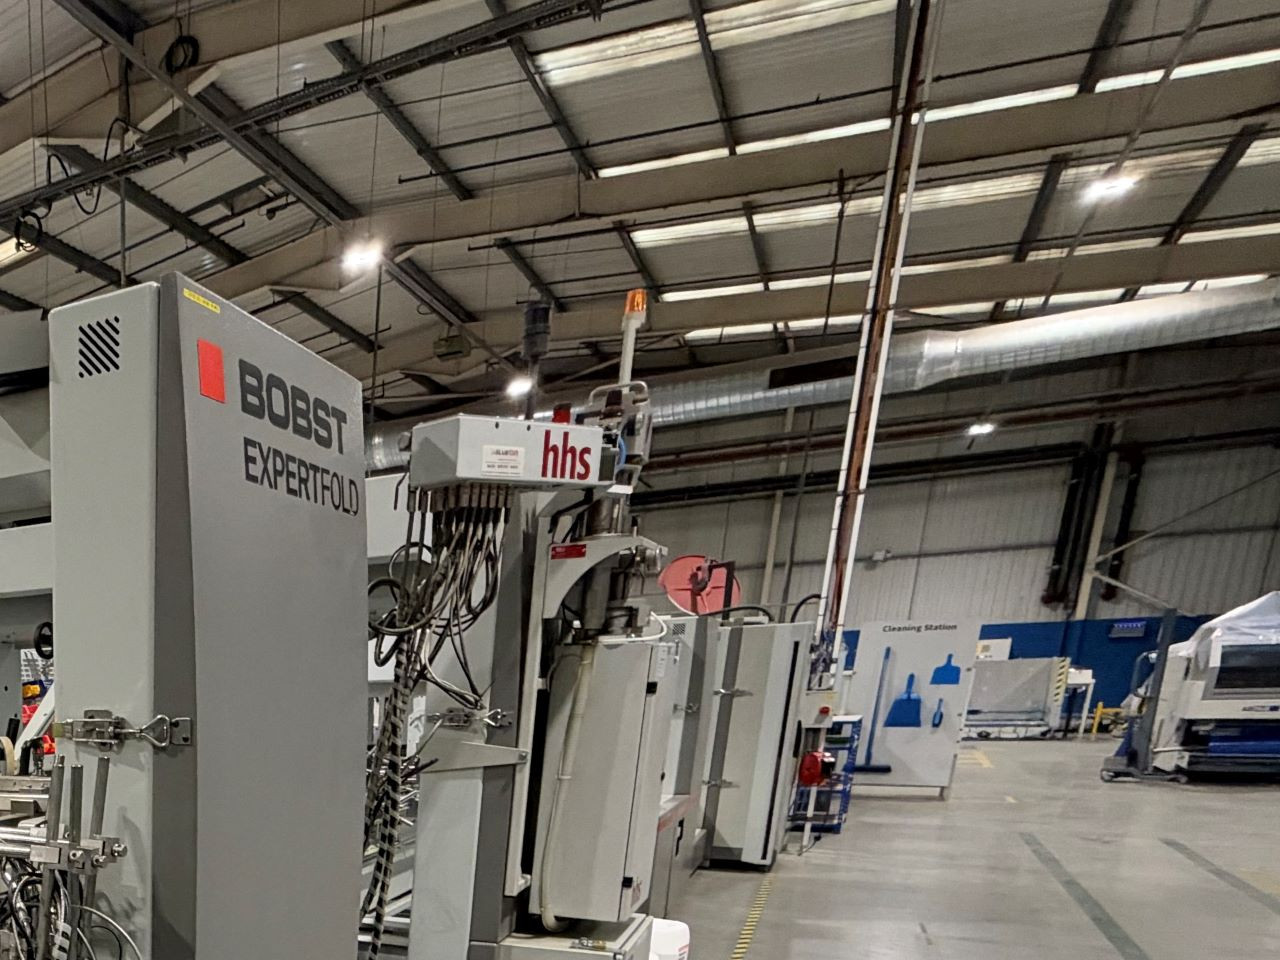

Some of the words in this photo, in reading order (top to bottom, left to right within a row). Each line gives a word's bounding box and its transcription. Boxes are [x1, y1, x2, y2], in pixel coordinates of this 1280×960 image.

[238, 358, 347, 455] BOBST
[243, 436, 360, 517] EXPERTFOLD
[541, 429, 592, 481] hhs
[882, 625, 922, 633] Cleaning
[924, 624, 957, 632] Station
